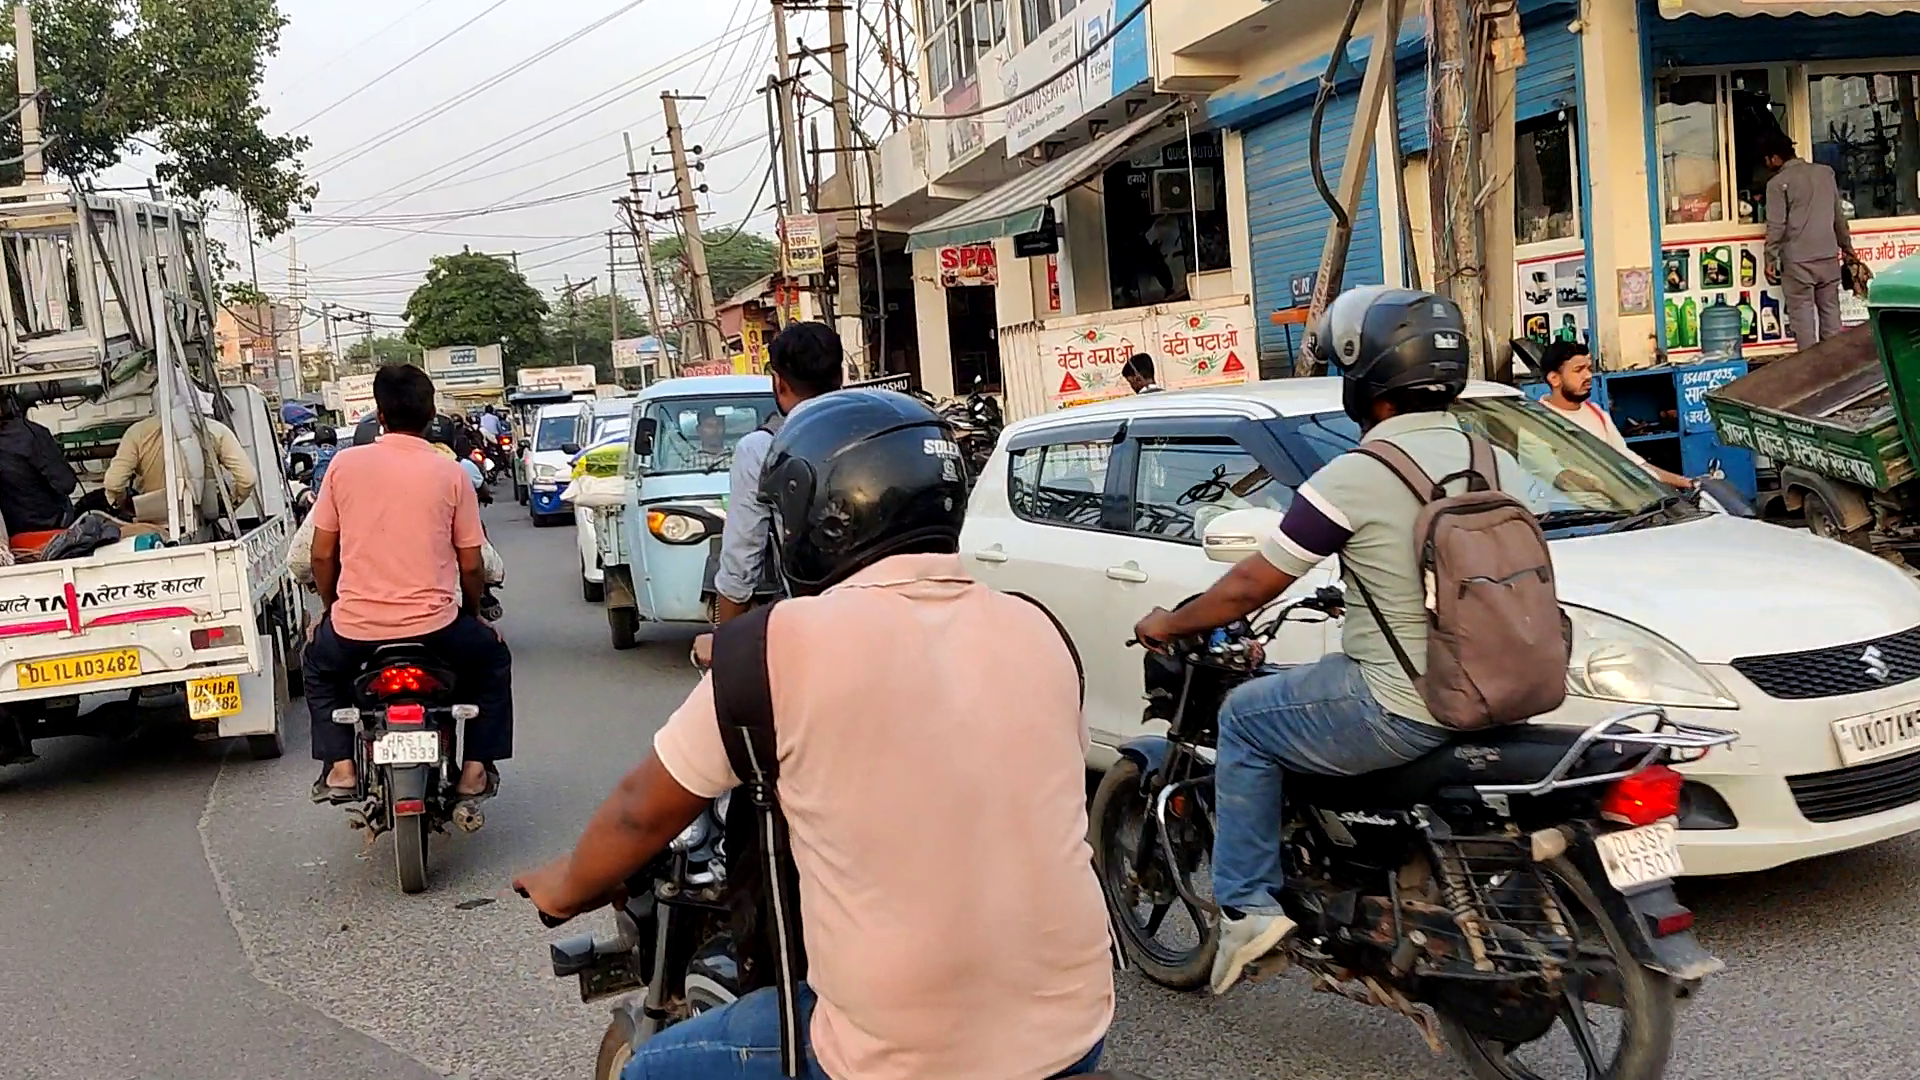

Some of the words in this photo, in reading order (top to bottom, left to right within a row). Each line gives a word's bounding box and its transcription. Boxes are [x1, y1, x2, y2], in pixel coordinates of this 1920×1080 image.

[940, 247, 995, 269] SPA
[161, 576, 205, 593] काला
[34, 593, 98, 612] TAA
[29, 654, 138, 683] DL1LAD3482
